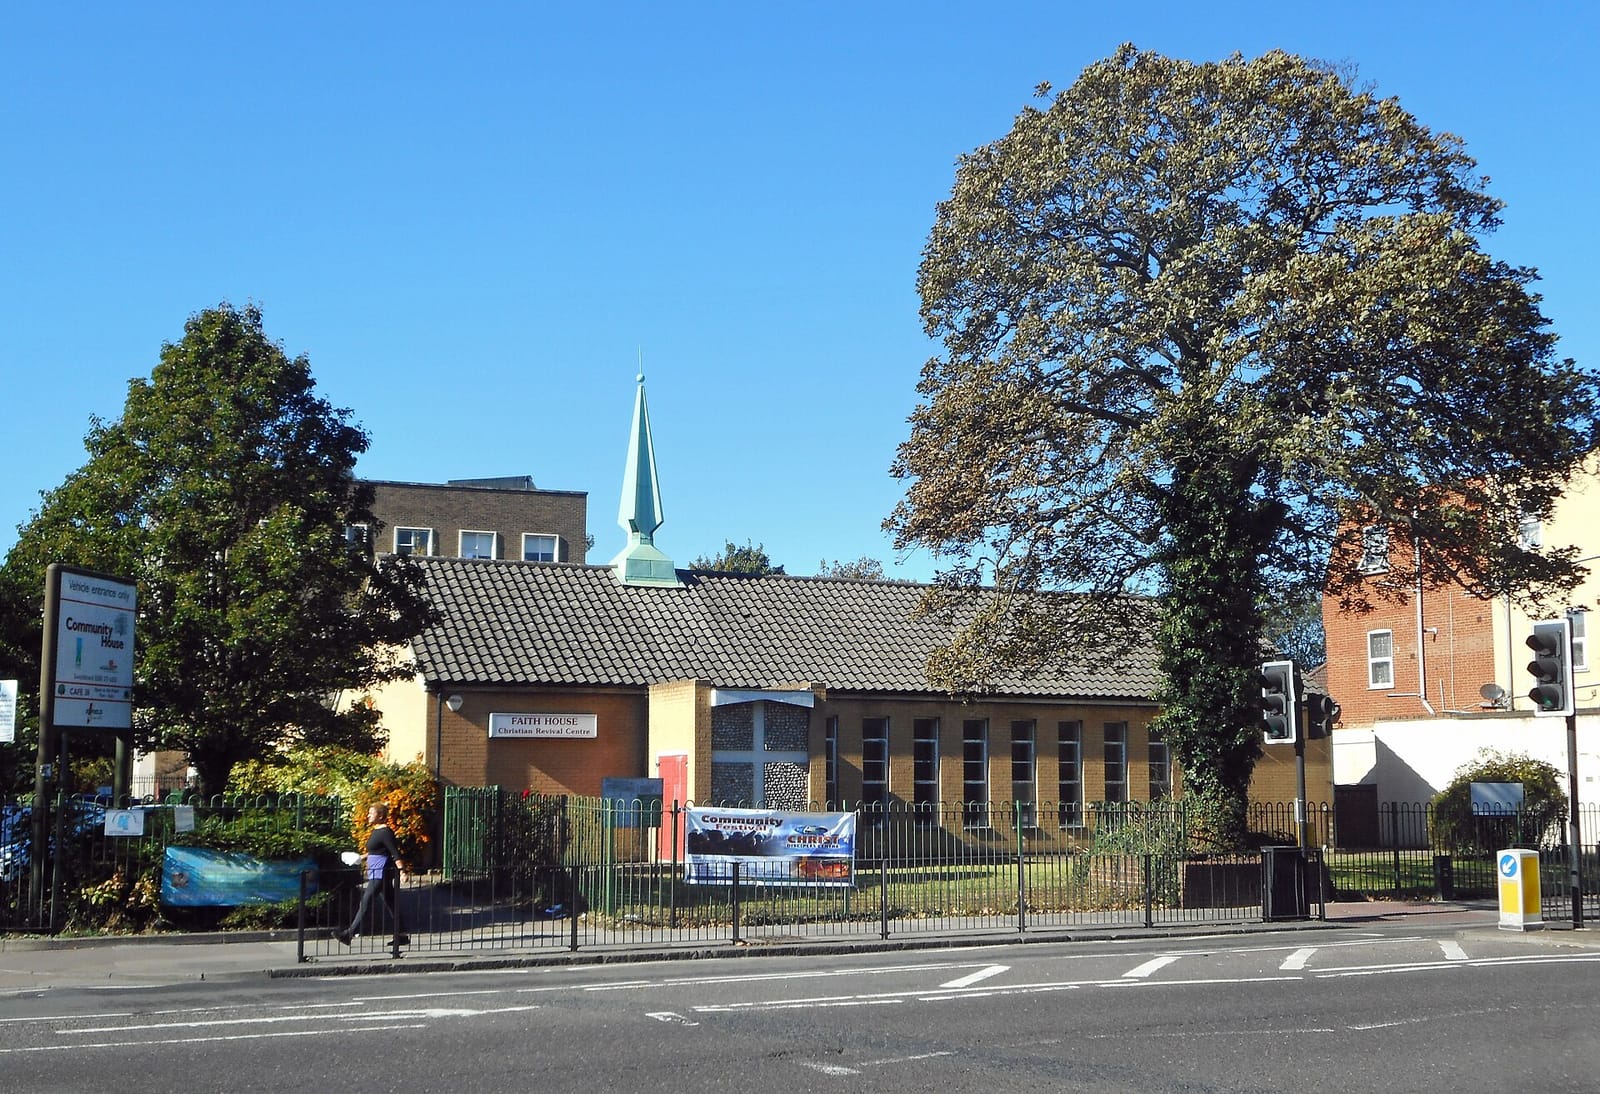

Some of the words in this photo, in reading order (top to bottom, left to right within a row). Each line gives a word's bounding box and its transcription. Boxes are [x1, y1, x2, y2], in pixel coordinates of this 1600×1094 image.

[69, 580, 90, 593] Vehicle
[91, 587, 117, 598] entrance
[117, 589, 130, 602] only
[66, 616, 113, 639] Community
[100, 635, 124, 650] House
[511, 717, 541, 726] FAITH
[544, 717, 578, 726] HOUSE
[498, 727, 533, 735] Christian
[535, 727, 563, 735] Revival
[701, 815, 784, 828] Community
[715, 823, 767, 832] Festival
[787, 834, 840, 845] CHRIST
